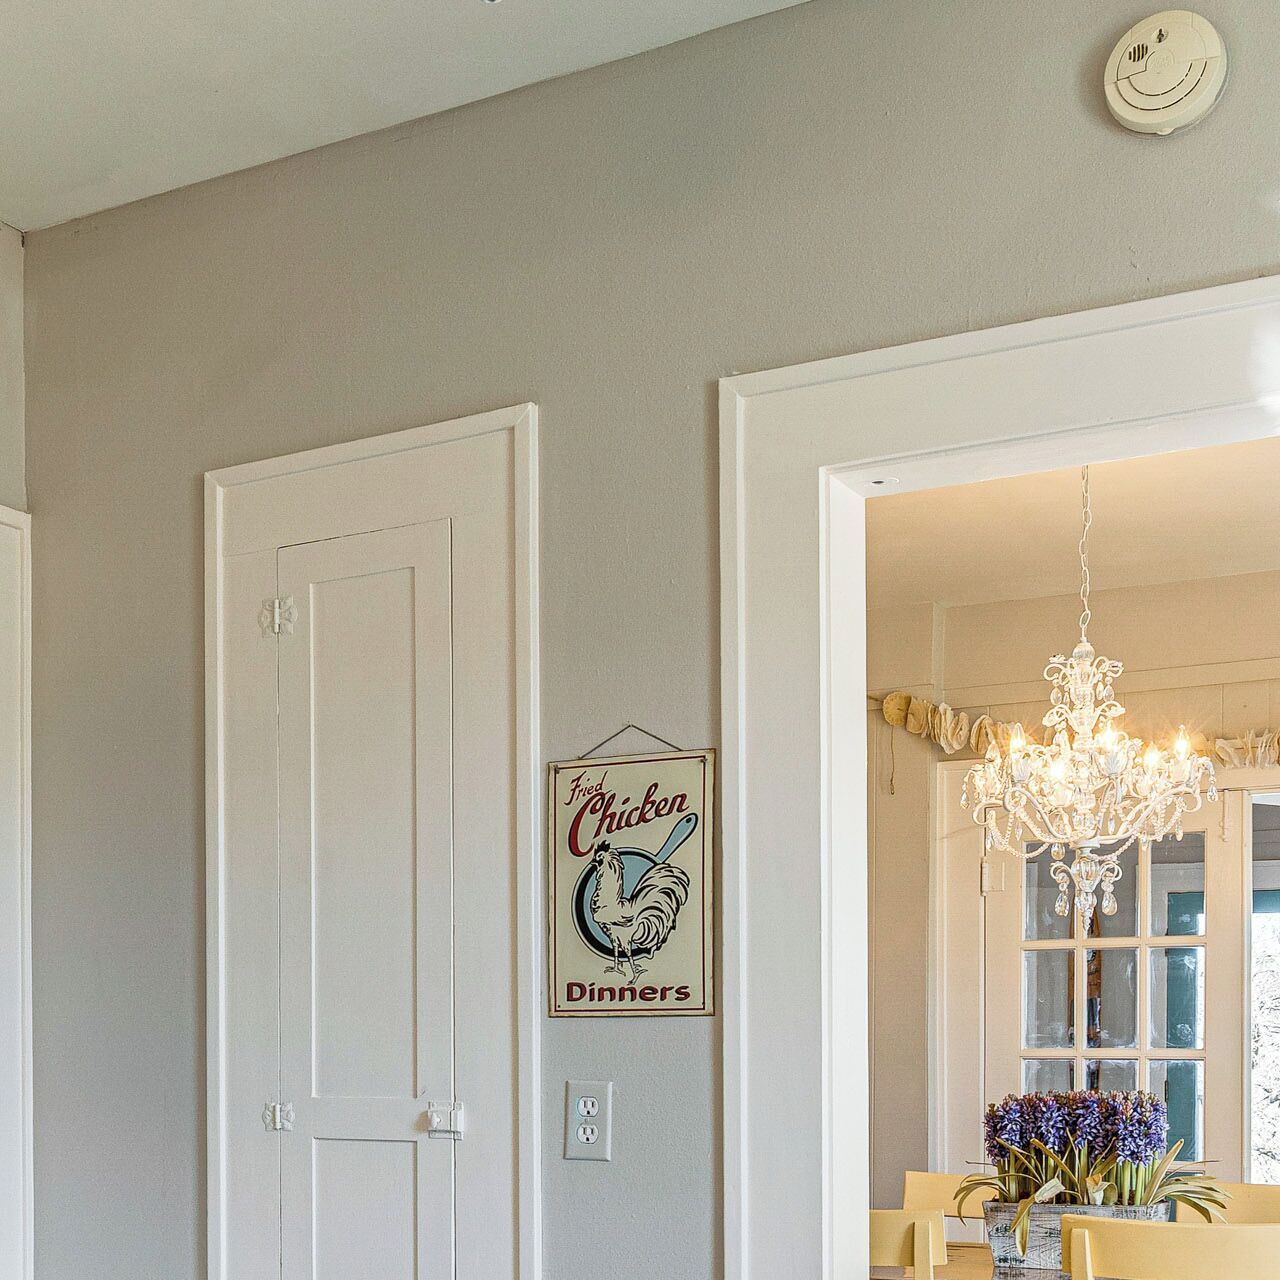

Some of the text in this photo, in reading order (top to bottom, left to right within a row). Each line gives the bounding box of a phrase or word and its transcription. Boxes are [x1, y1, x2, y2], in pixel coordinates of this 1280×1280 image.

[563, 770, 609, 806] Fried
[568, 782, 690, 857] Chicken
[566, 981, 692, 1003] Dinners
